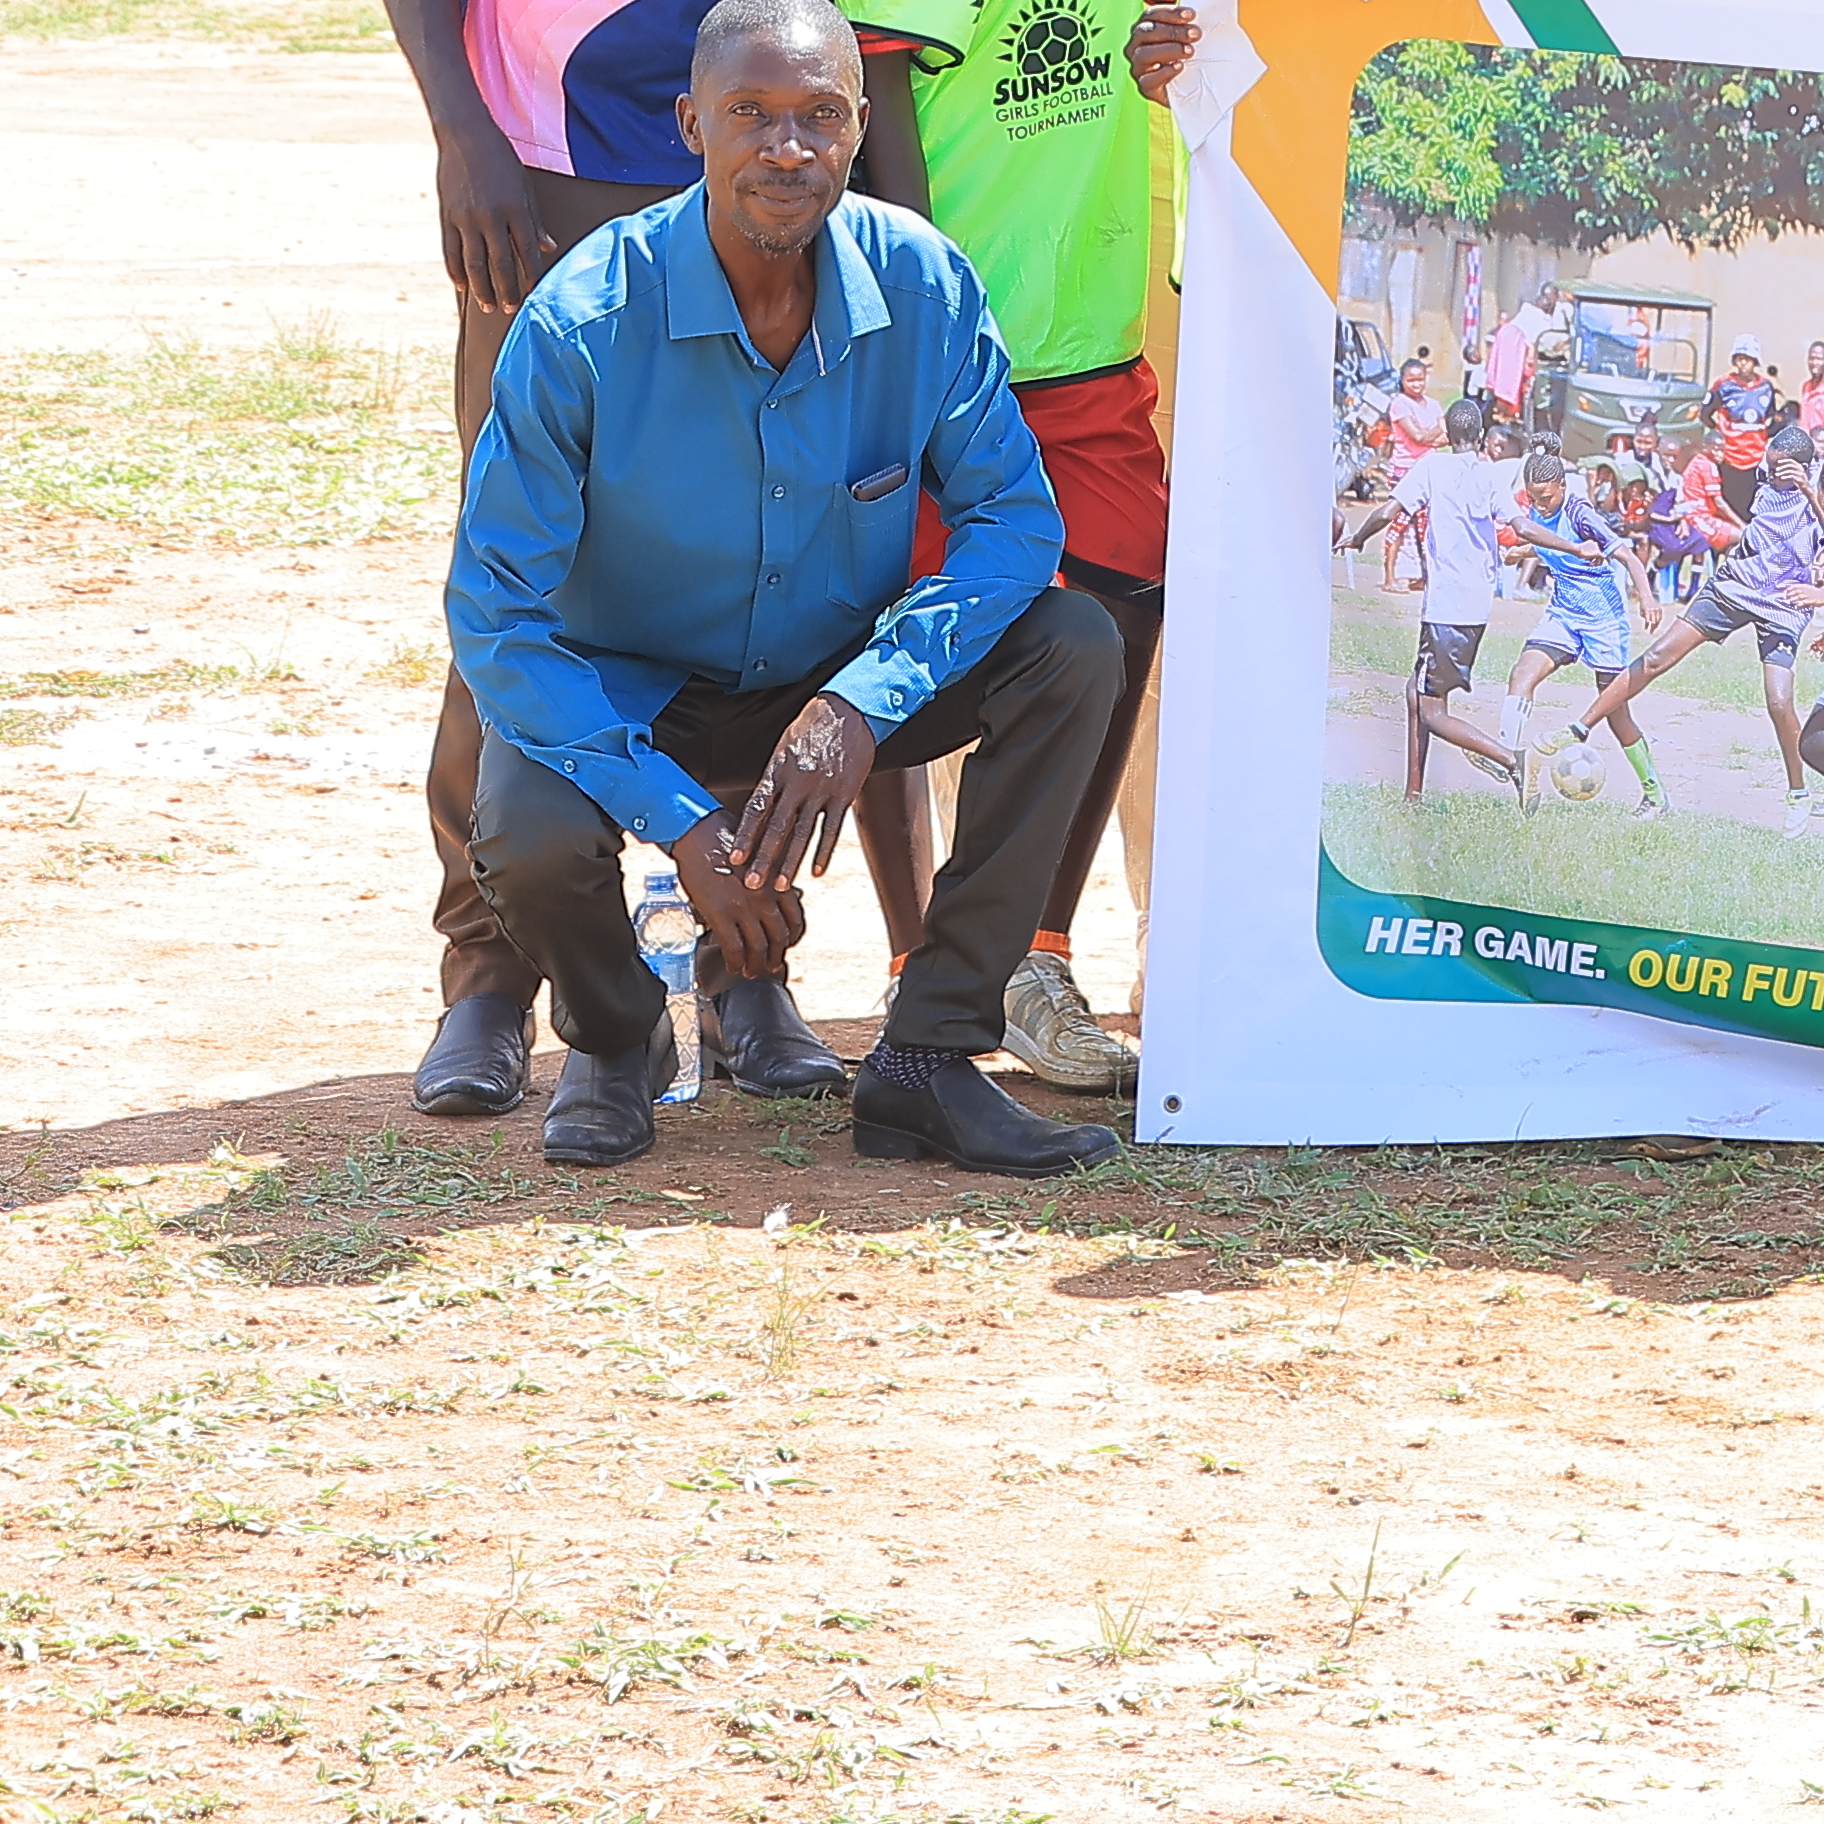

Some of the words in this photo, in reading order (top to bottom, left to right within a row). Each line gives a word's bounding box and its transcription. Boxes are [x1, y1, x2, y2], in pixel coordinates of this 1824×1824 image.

[993, 53, 1111, 106] SUNSOW
[996, 103, 1039, 122] GIRLS
[1043, 82, 1114, 113] FOOTBALL
[1007, 104, 1106, 141] TOURNAMENT
[1365, 916, 1464, 958] HER
[1474, 926, 1608, 981] GAME.
[1627, 948, 1735, 1001] OUR
